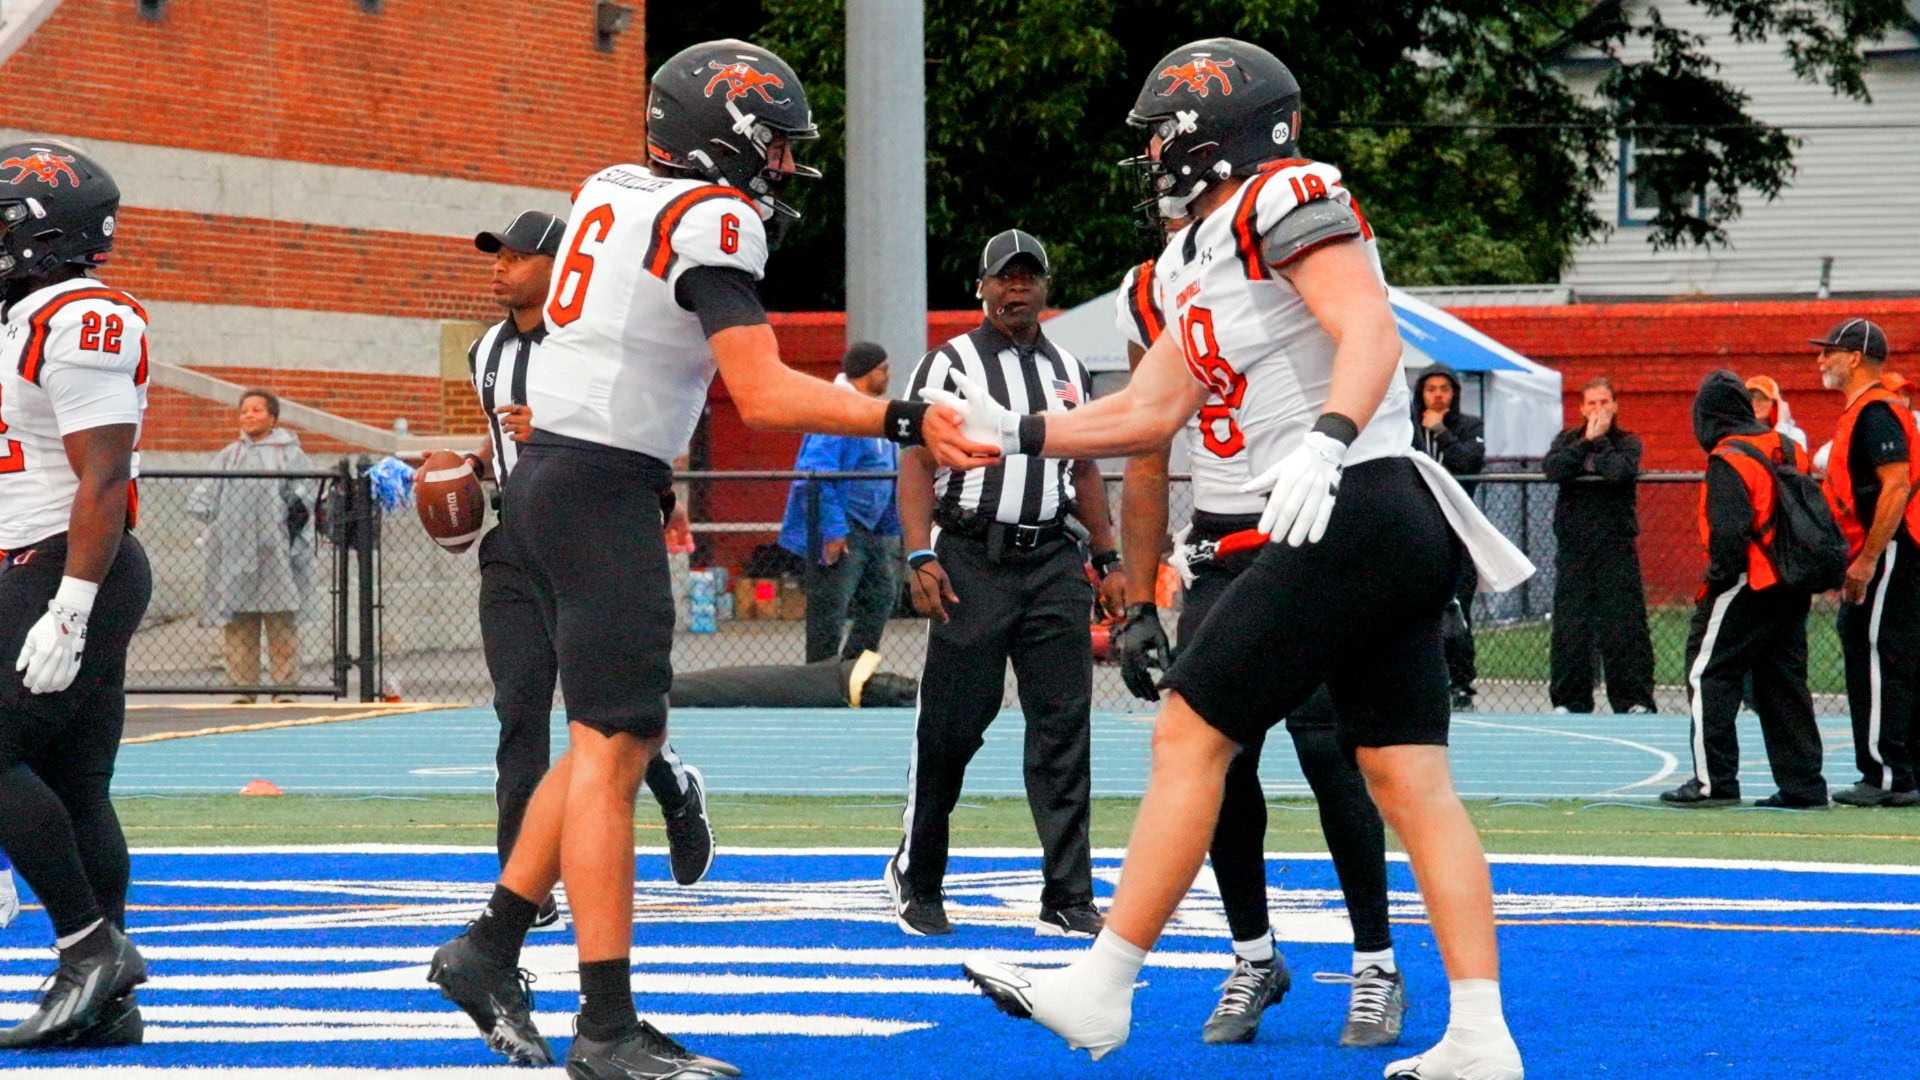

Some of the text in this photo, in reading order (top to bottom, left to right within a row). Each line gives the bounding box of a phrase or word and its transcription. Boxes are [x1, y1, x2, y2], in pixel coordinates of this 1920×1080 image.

[1275, 128, 1287, 139] DS
[1289, 173, 1328, 206] 18
[720, 213, 740, 255] 6
[547, 203, 615, 328] 6
[79, 310, 124, 354] 22
[1179, 304, 1248, 410] 18
